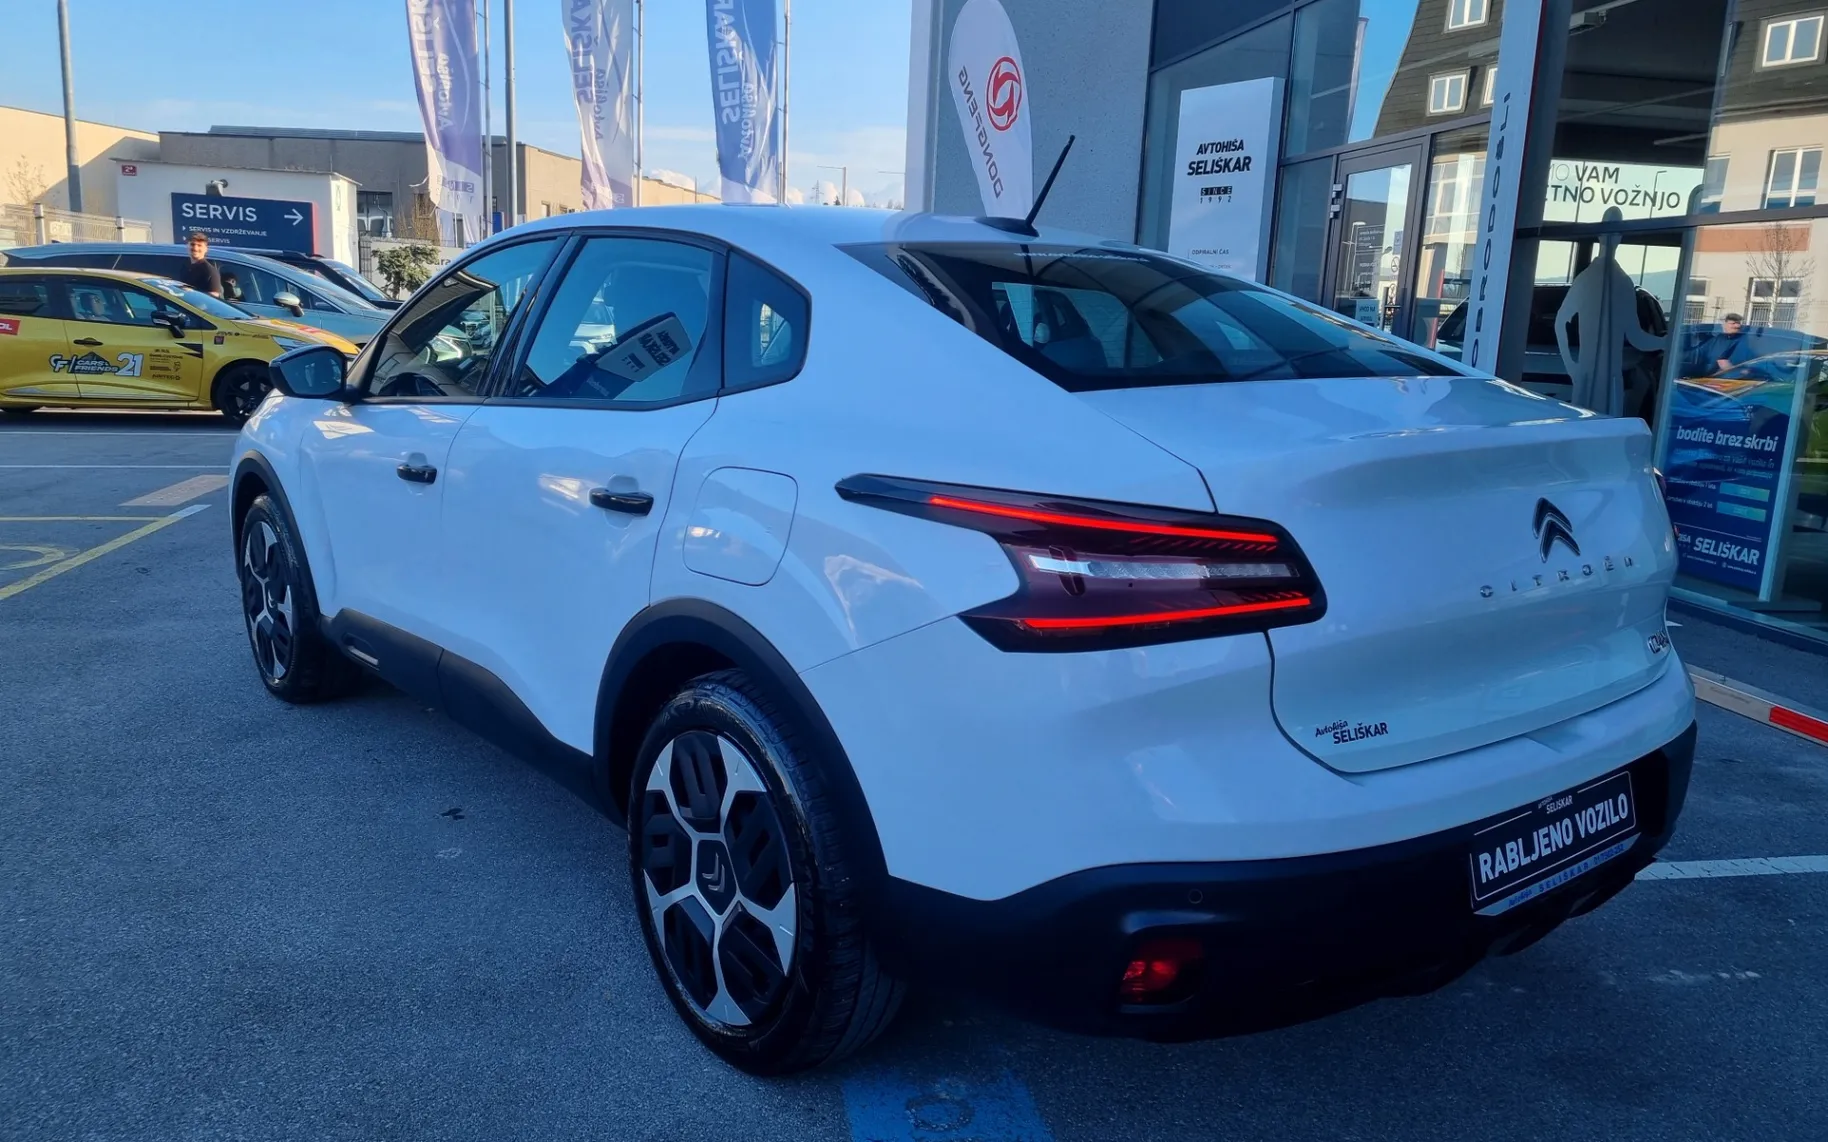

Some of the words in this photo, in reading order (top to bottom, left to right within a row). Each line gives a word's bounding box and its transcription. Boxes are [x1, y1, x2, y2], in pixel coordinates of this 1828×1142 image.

[1196, 139, 1245, 156] AVTOHIŠA
[1187, 156, 1252, 176] SELIŠKAR
[1575, 165, 1620, 184] VAM
[1200, 196, 1232, 204] 1992
[1201, 187, 1232, 196] SINCE
[1546, 184, 1595, 204] TNO
[1601, 184, 1680, 211] VOŽNJO
[182, 202, 258, 222] SERVIS
[221, 228, 267, 237] VZDRŽEVANJE
[114, 352, 144, 376] 21
[1676, 425, 1714, 443] bodite
[1715, 430, 1744, 448] brez
[1743, 434, 1779, 452] skrbi
[1693, 537, 1760, 565] SELIŠKAR
[1315, 719, 1348, 738] Avtohiša
[1333, 722, 1388, 744] SELIŠKAR
[1479, 818, 1573, 884] RABLJENO
[1575, 793, 1629, 839] VOZILO
